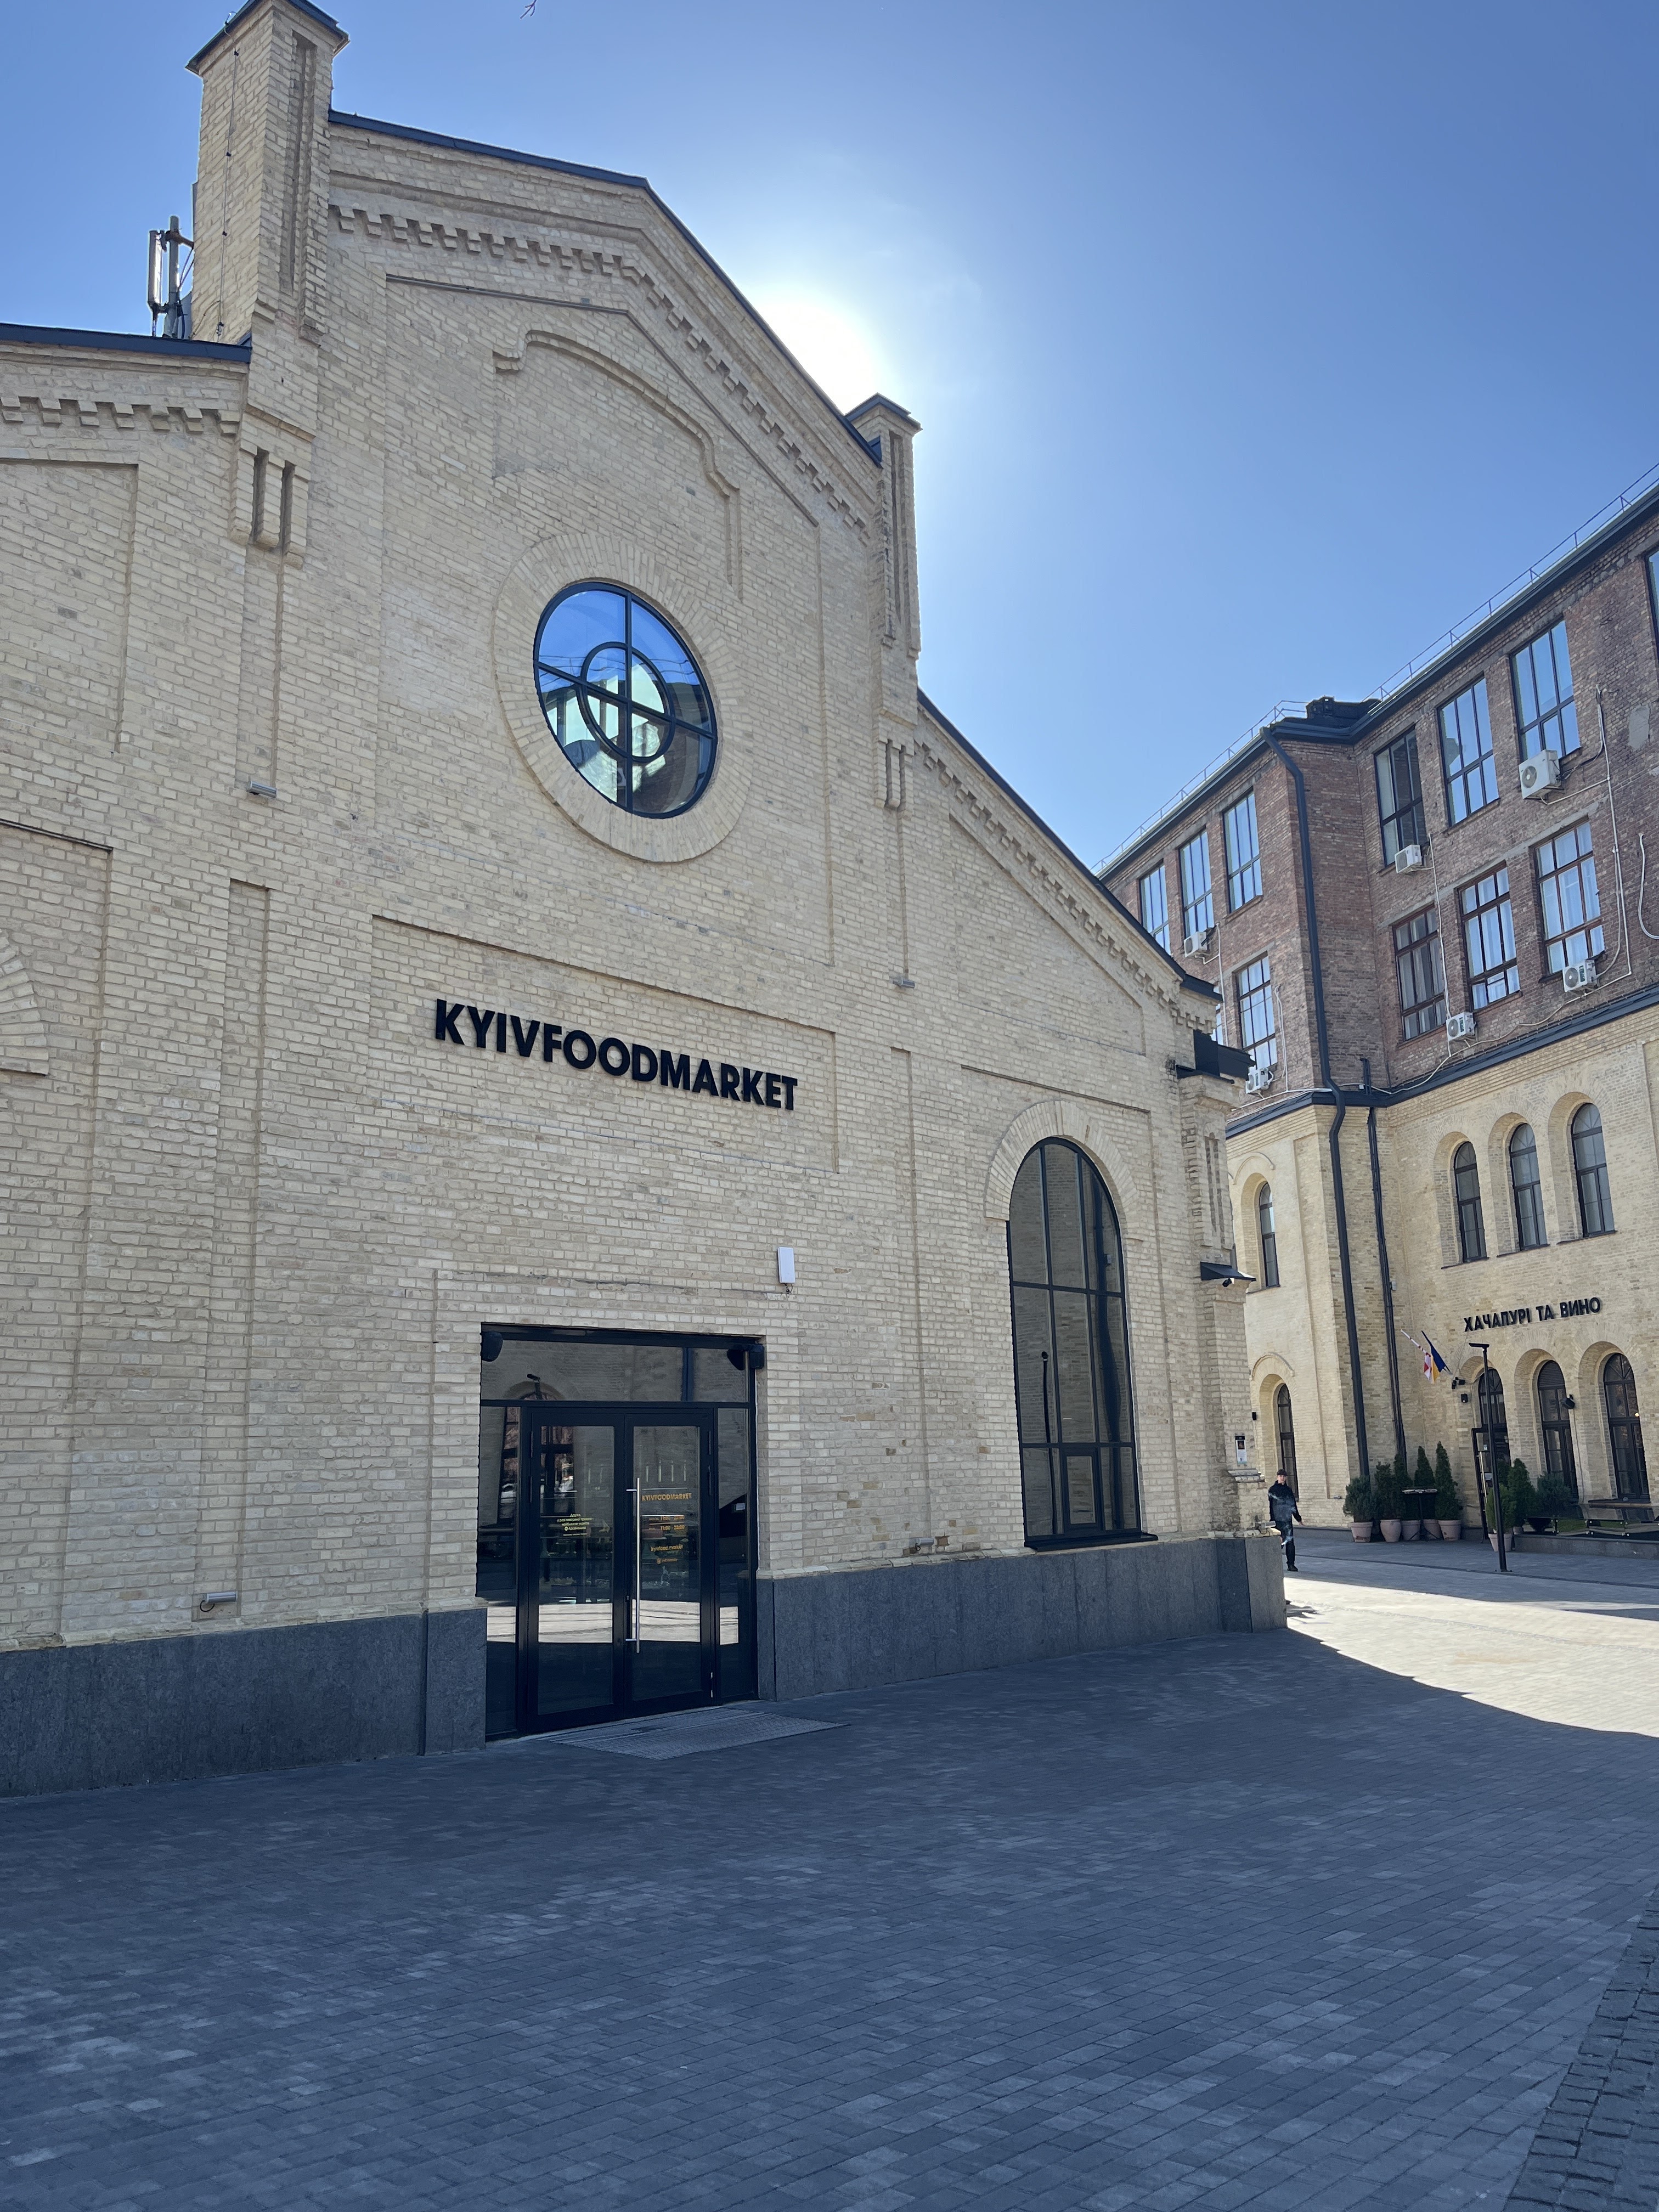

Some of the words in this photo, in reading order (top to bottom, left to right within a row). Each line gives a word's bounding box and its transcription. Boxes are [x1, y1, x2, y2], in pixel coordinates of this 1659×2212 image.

[436, 998, 798, 1111] KYIVFOODMARKET
[1464, 1308, 1531, 1332] ХАЧАПУРІ
[1536, 1305, 1554, 1321] ТА
[1560, 1297, 1601, 1318] ВИНО
